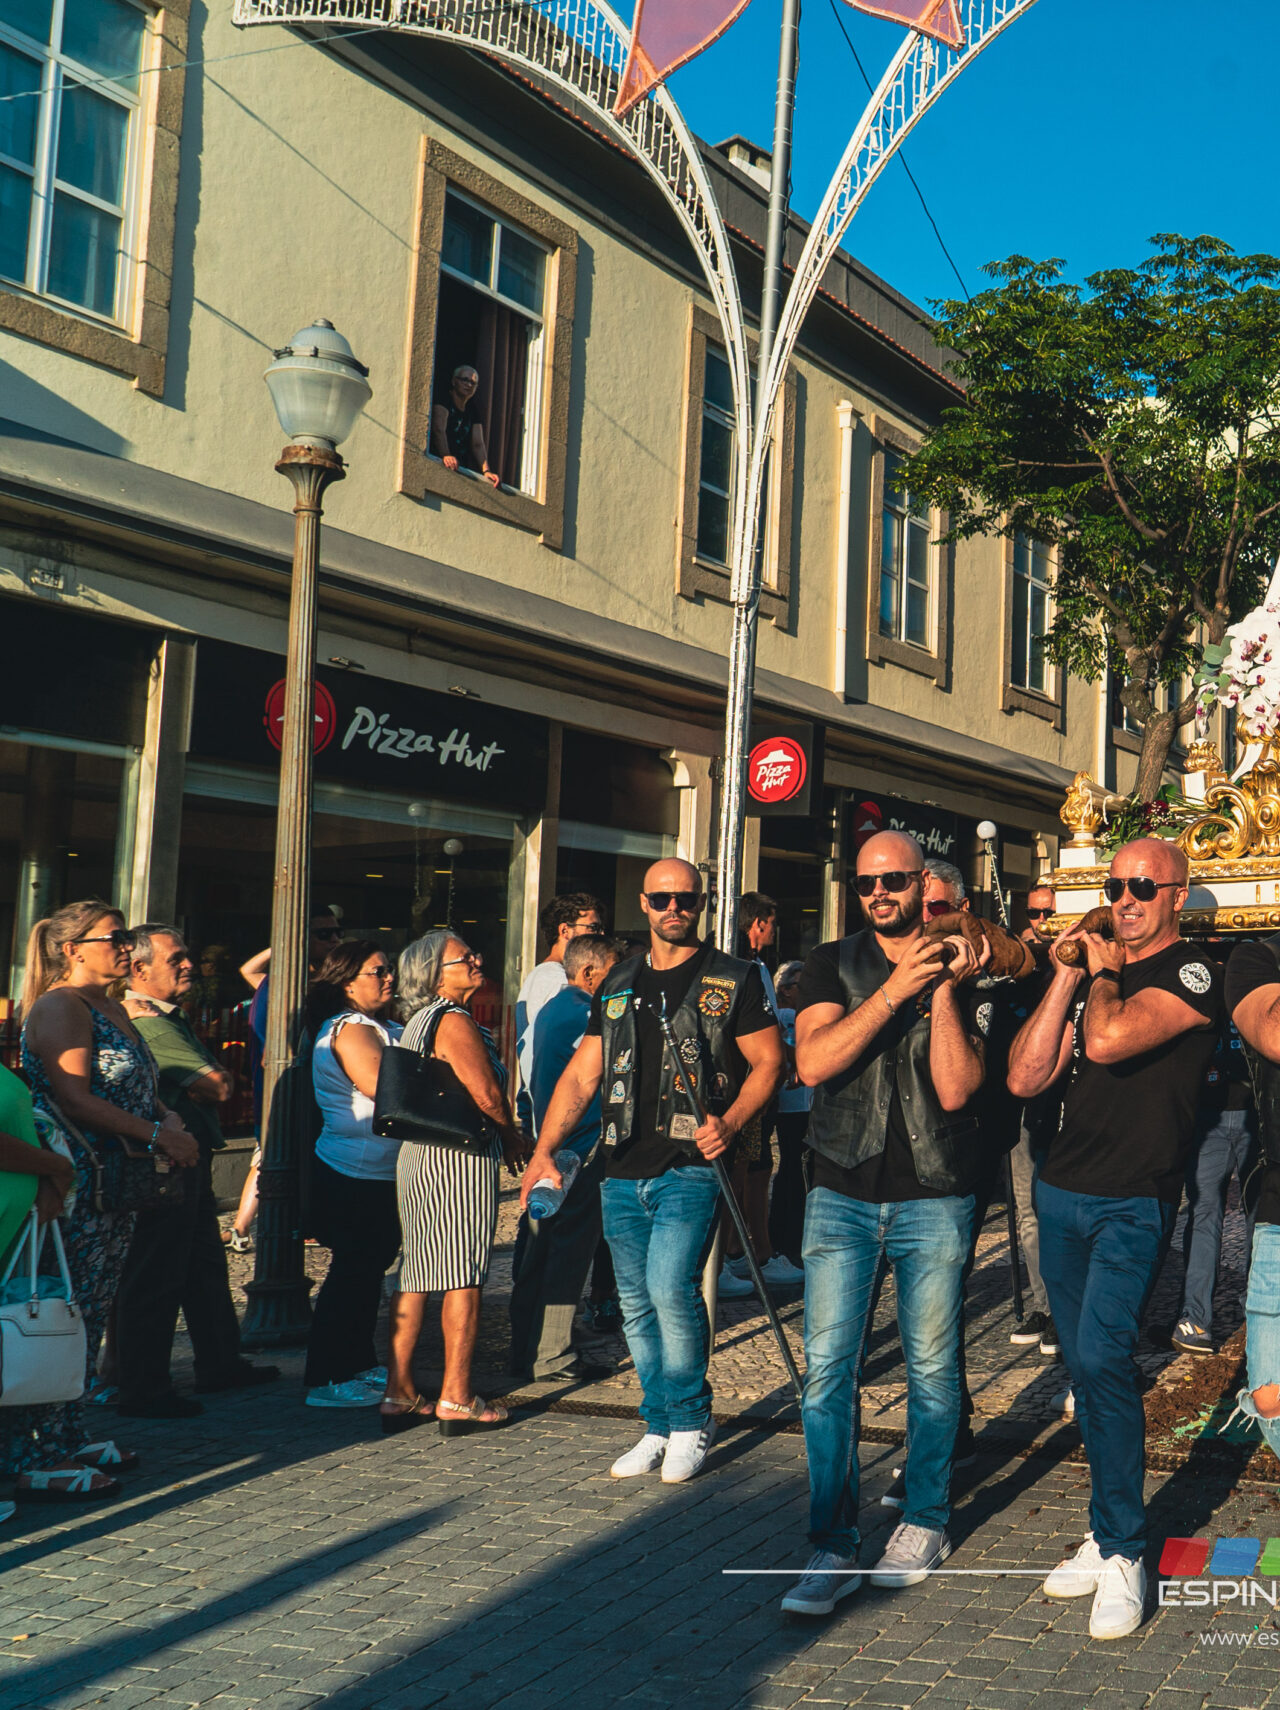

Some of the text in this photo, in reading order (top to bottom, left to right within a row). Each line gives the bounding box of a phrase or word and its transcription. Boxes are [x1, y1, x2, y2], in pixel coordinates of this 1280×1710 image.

[341, 706, 506, 772] Pizza Hut
[756, 762, 792, 782] Pizza
[762, 774, 790, 792] Hut
[927, 828, 955, 855] Hut
